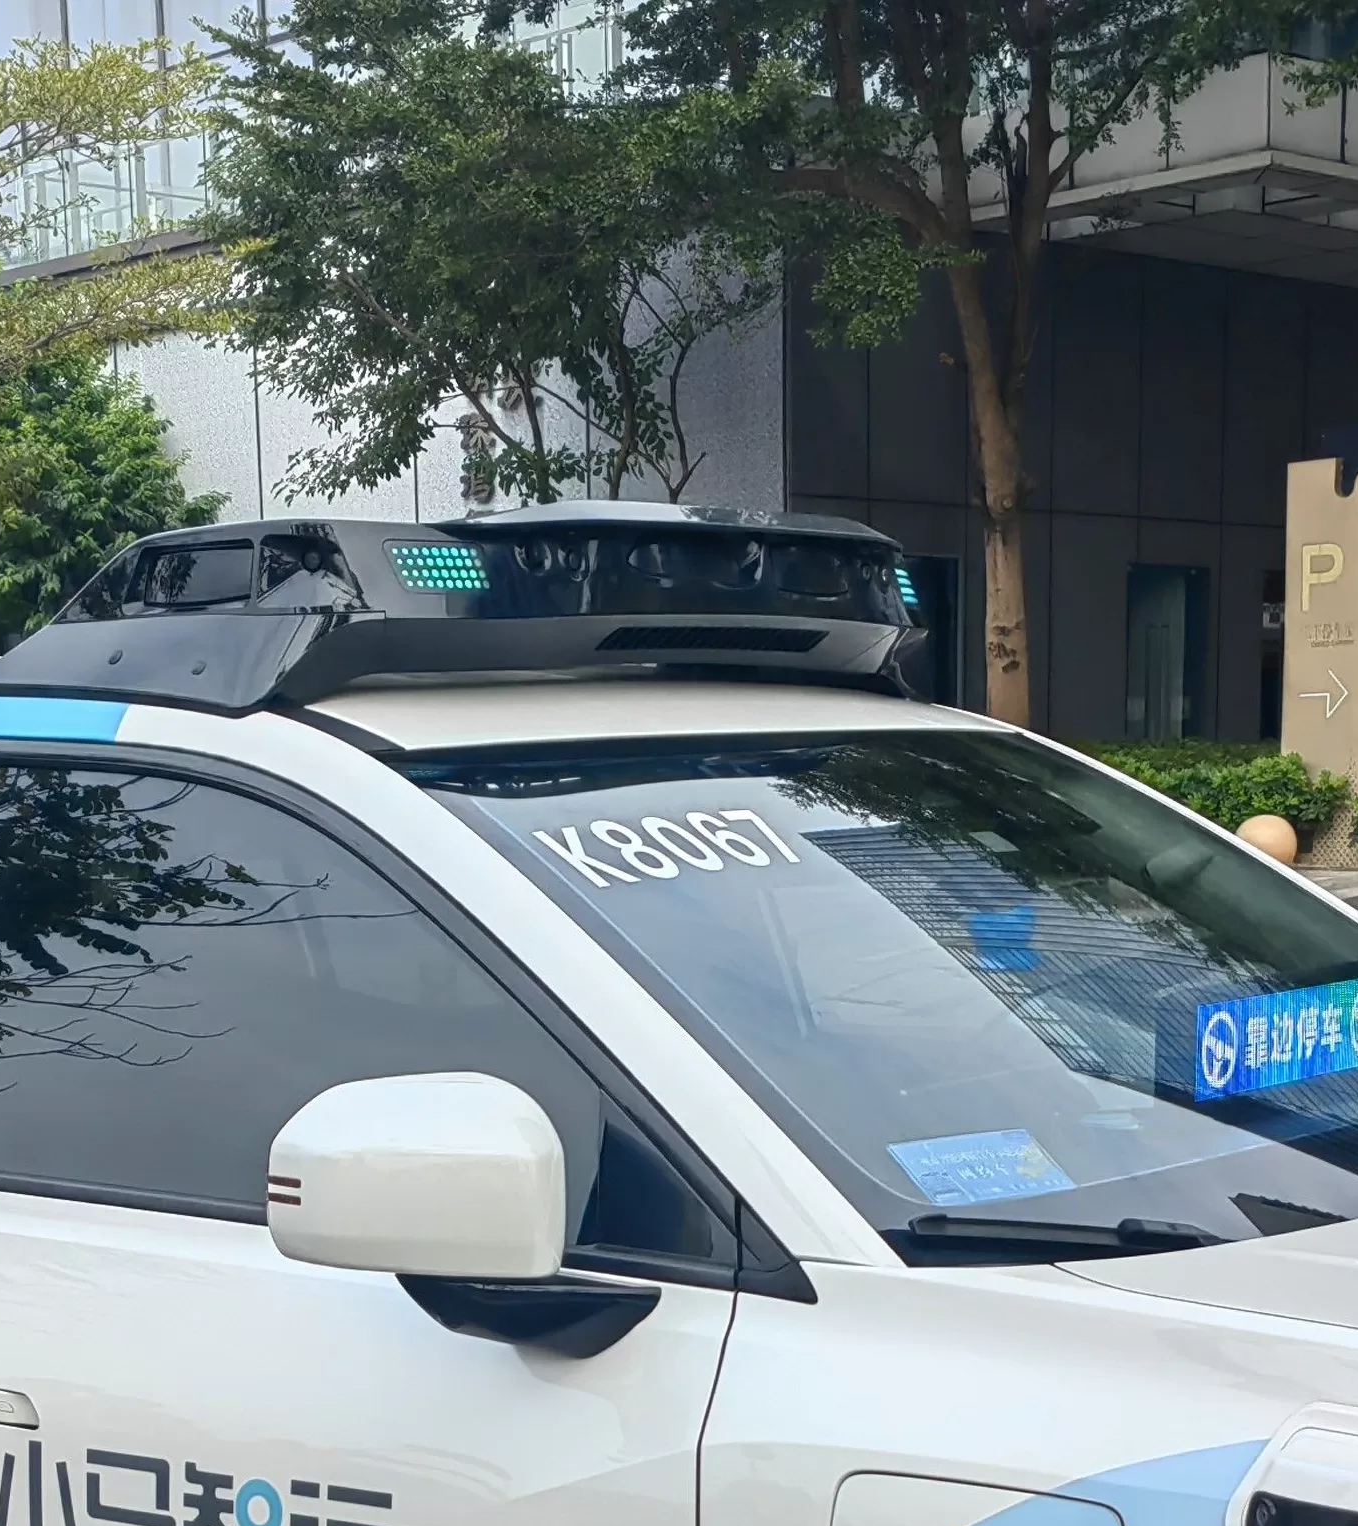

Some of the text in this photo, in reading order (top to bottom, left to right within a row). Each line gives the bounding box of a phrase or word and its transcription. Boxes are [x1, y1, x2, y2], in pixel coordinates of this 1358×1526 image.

[1302, 543, 1344, 612] P
[531, 808, 802, 889] K8067
[1244, 1000, 1343, 1071] 靠边停车
